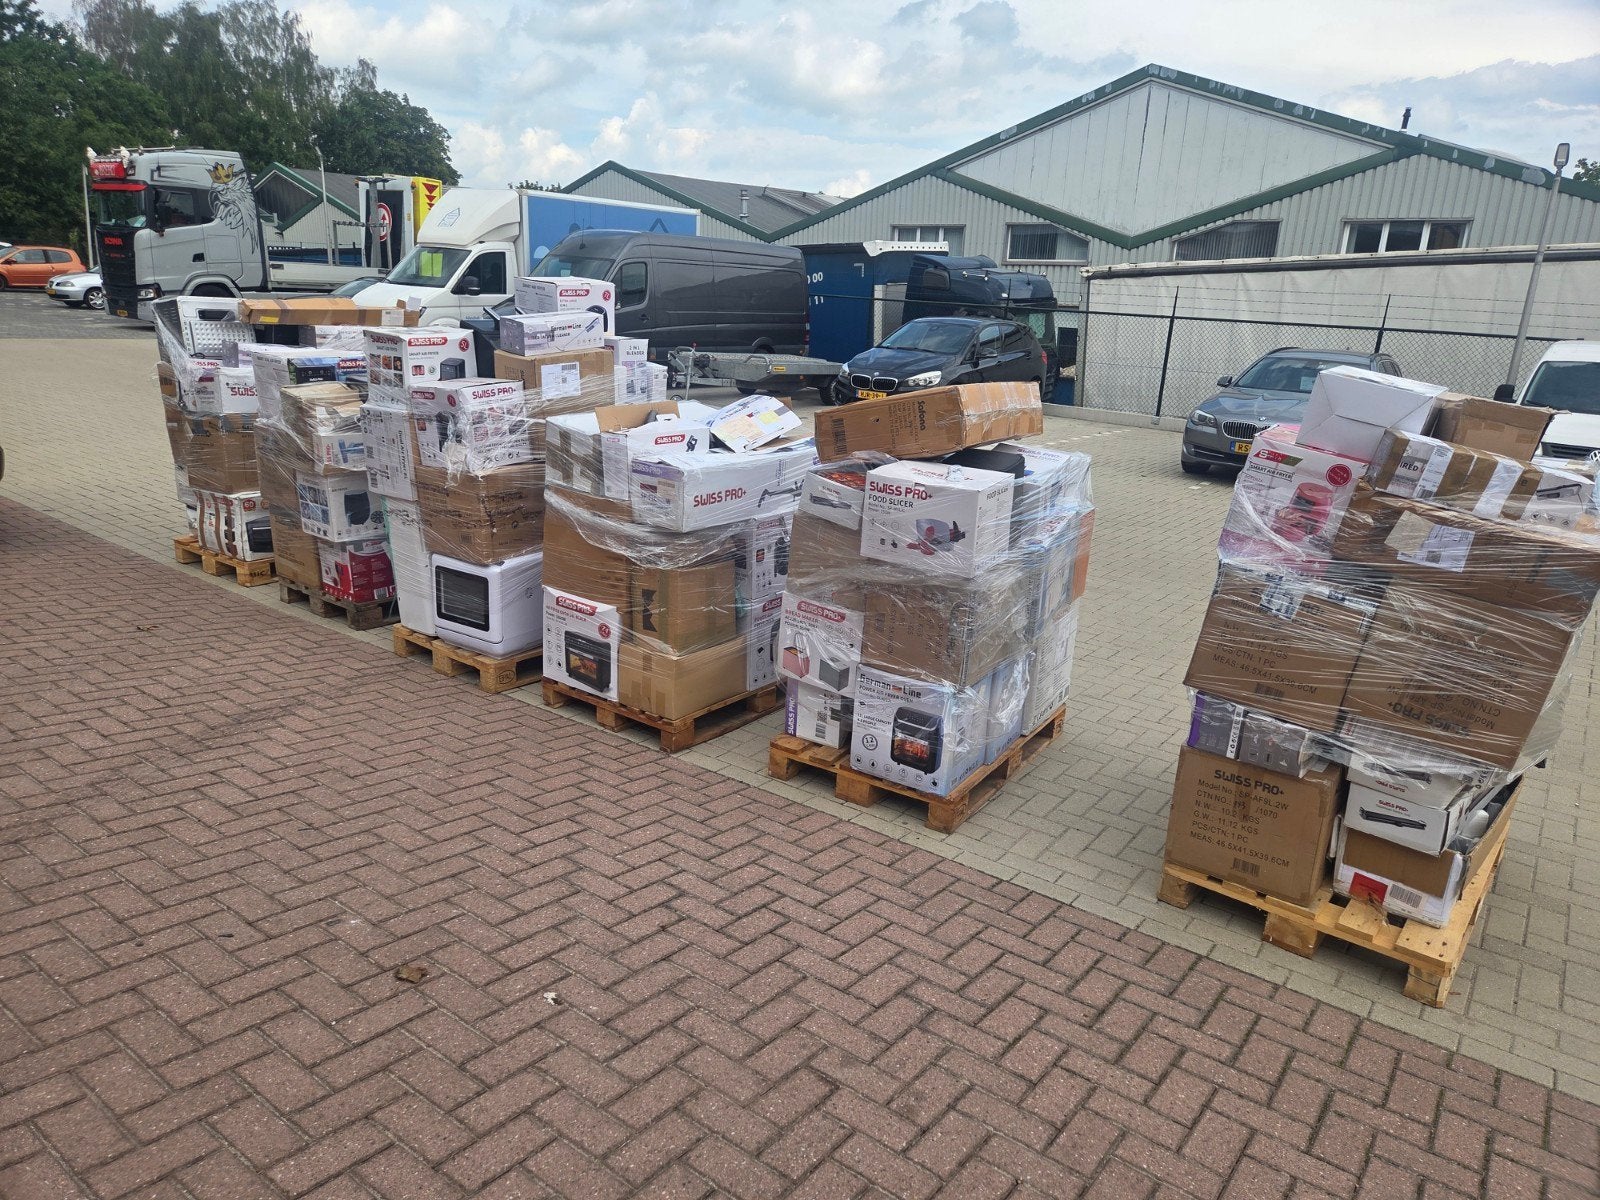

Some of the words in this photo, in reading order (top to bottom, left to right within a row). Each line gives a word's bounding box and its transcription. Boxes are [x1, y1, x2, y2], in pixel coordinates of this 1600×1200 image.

[104, 237, 123, 245] SCANIA
[230, 386, 258, 397] SWIS
[472, 390, 497, 400] SWISS
[656, 436, 672, 444] SWISS
[1249, 464, 1267, 473] SMART
[1277, 470, 1293, 480] FRYER
[693, 490, 723, 508] SWISS
[724, 487, 748, 502] PRO+
[869, 481, 903, 497] SWISS
[904, 486, 933, 501] PRO+
[868, 494, 888, 504] FOOD
[888, 497, 914, 509] SLICER
[557, 597, 577, 610] SWISS
[800, 602, 824, 615] SWISS
[822, 609, 843, 621] PRO+
[1262, 657, 1277, 669] PC
[860, 673, 892, 691] German
[903, 684, 922, 699] Line
[1386, 702, 1424, 721] PRO+
[1480, 702, 1502, 717] CTN
[787, 711, 796, 735] SWISS
[1424, 713, 1471, 738] SWISS
[1466, 713, 1496, 730] Model
[1197, 778, 1221, 792] Model
[1214, 769, 1252, 788] SWISS
[1253, 779, 1285, 796] PRO+
[1196, 789, 1214, 801] CTN
[1190, 829, 1215, 845] MEAS:
[1240, 824, 1259, 836] KGS
[1236, 834, 1250, 844] PC
